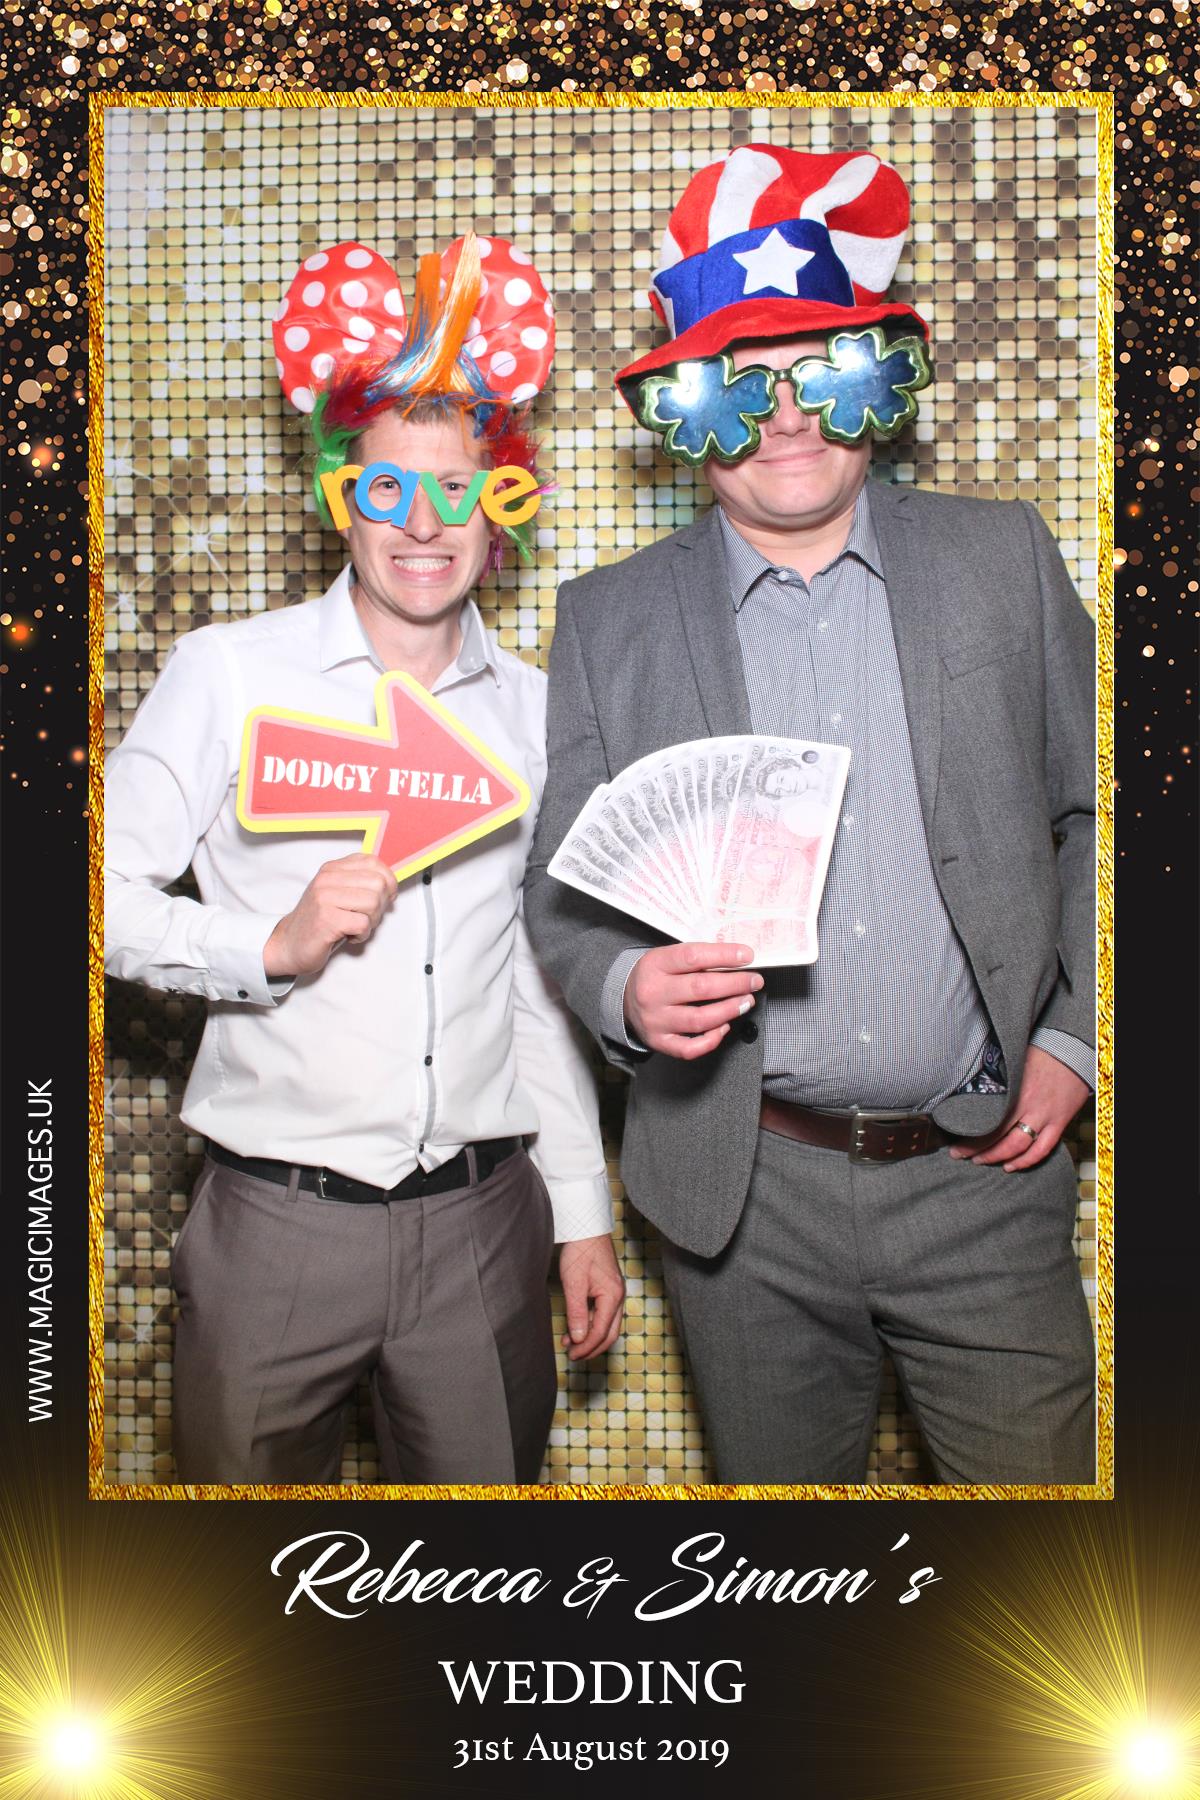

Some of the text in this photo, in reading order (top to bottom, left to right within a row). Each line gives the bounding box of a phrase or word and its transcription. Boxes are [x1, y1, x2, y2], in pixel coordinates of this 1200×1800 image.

[320, 461, 541, 530] rave
[261, 755, 493, 805] DODGY FELLA
